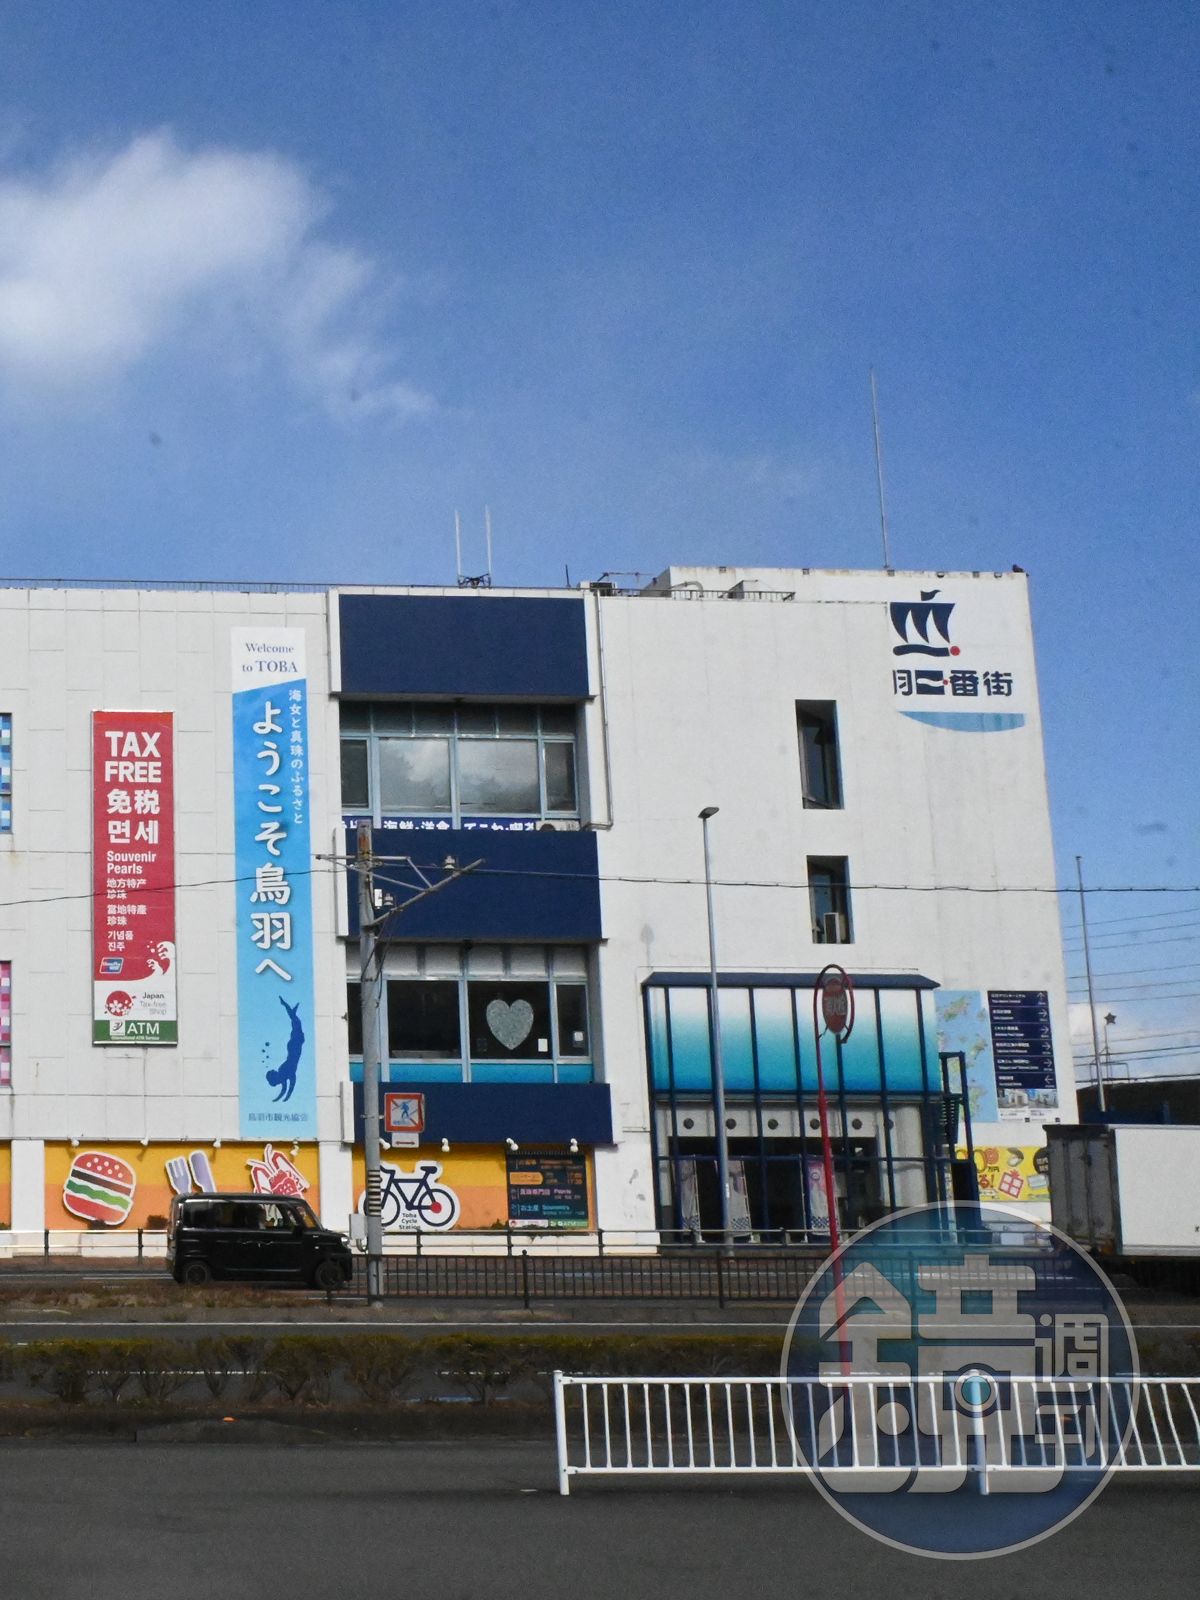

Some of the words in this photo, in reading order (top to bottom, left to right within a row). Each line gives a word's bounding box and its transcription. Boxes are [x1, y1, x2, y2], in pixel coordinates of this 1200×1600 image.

[245, 642, 294, 654] Welcome
[242, 664, 253, 672] to
[255, 660, 298, 673] TOBA
[104, 731, 161, 758] TAX
[104, 761, 162, 783] FREE
[108, 820, 159, 844] 면세
[250, 701, 292, 981] ようこそ鳥羽へ
[107, 850, 156, 862] Souvenir
[107, 863, 143, 874] Pearls
[127, 1022, 160, 1034] ATM
